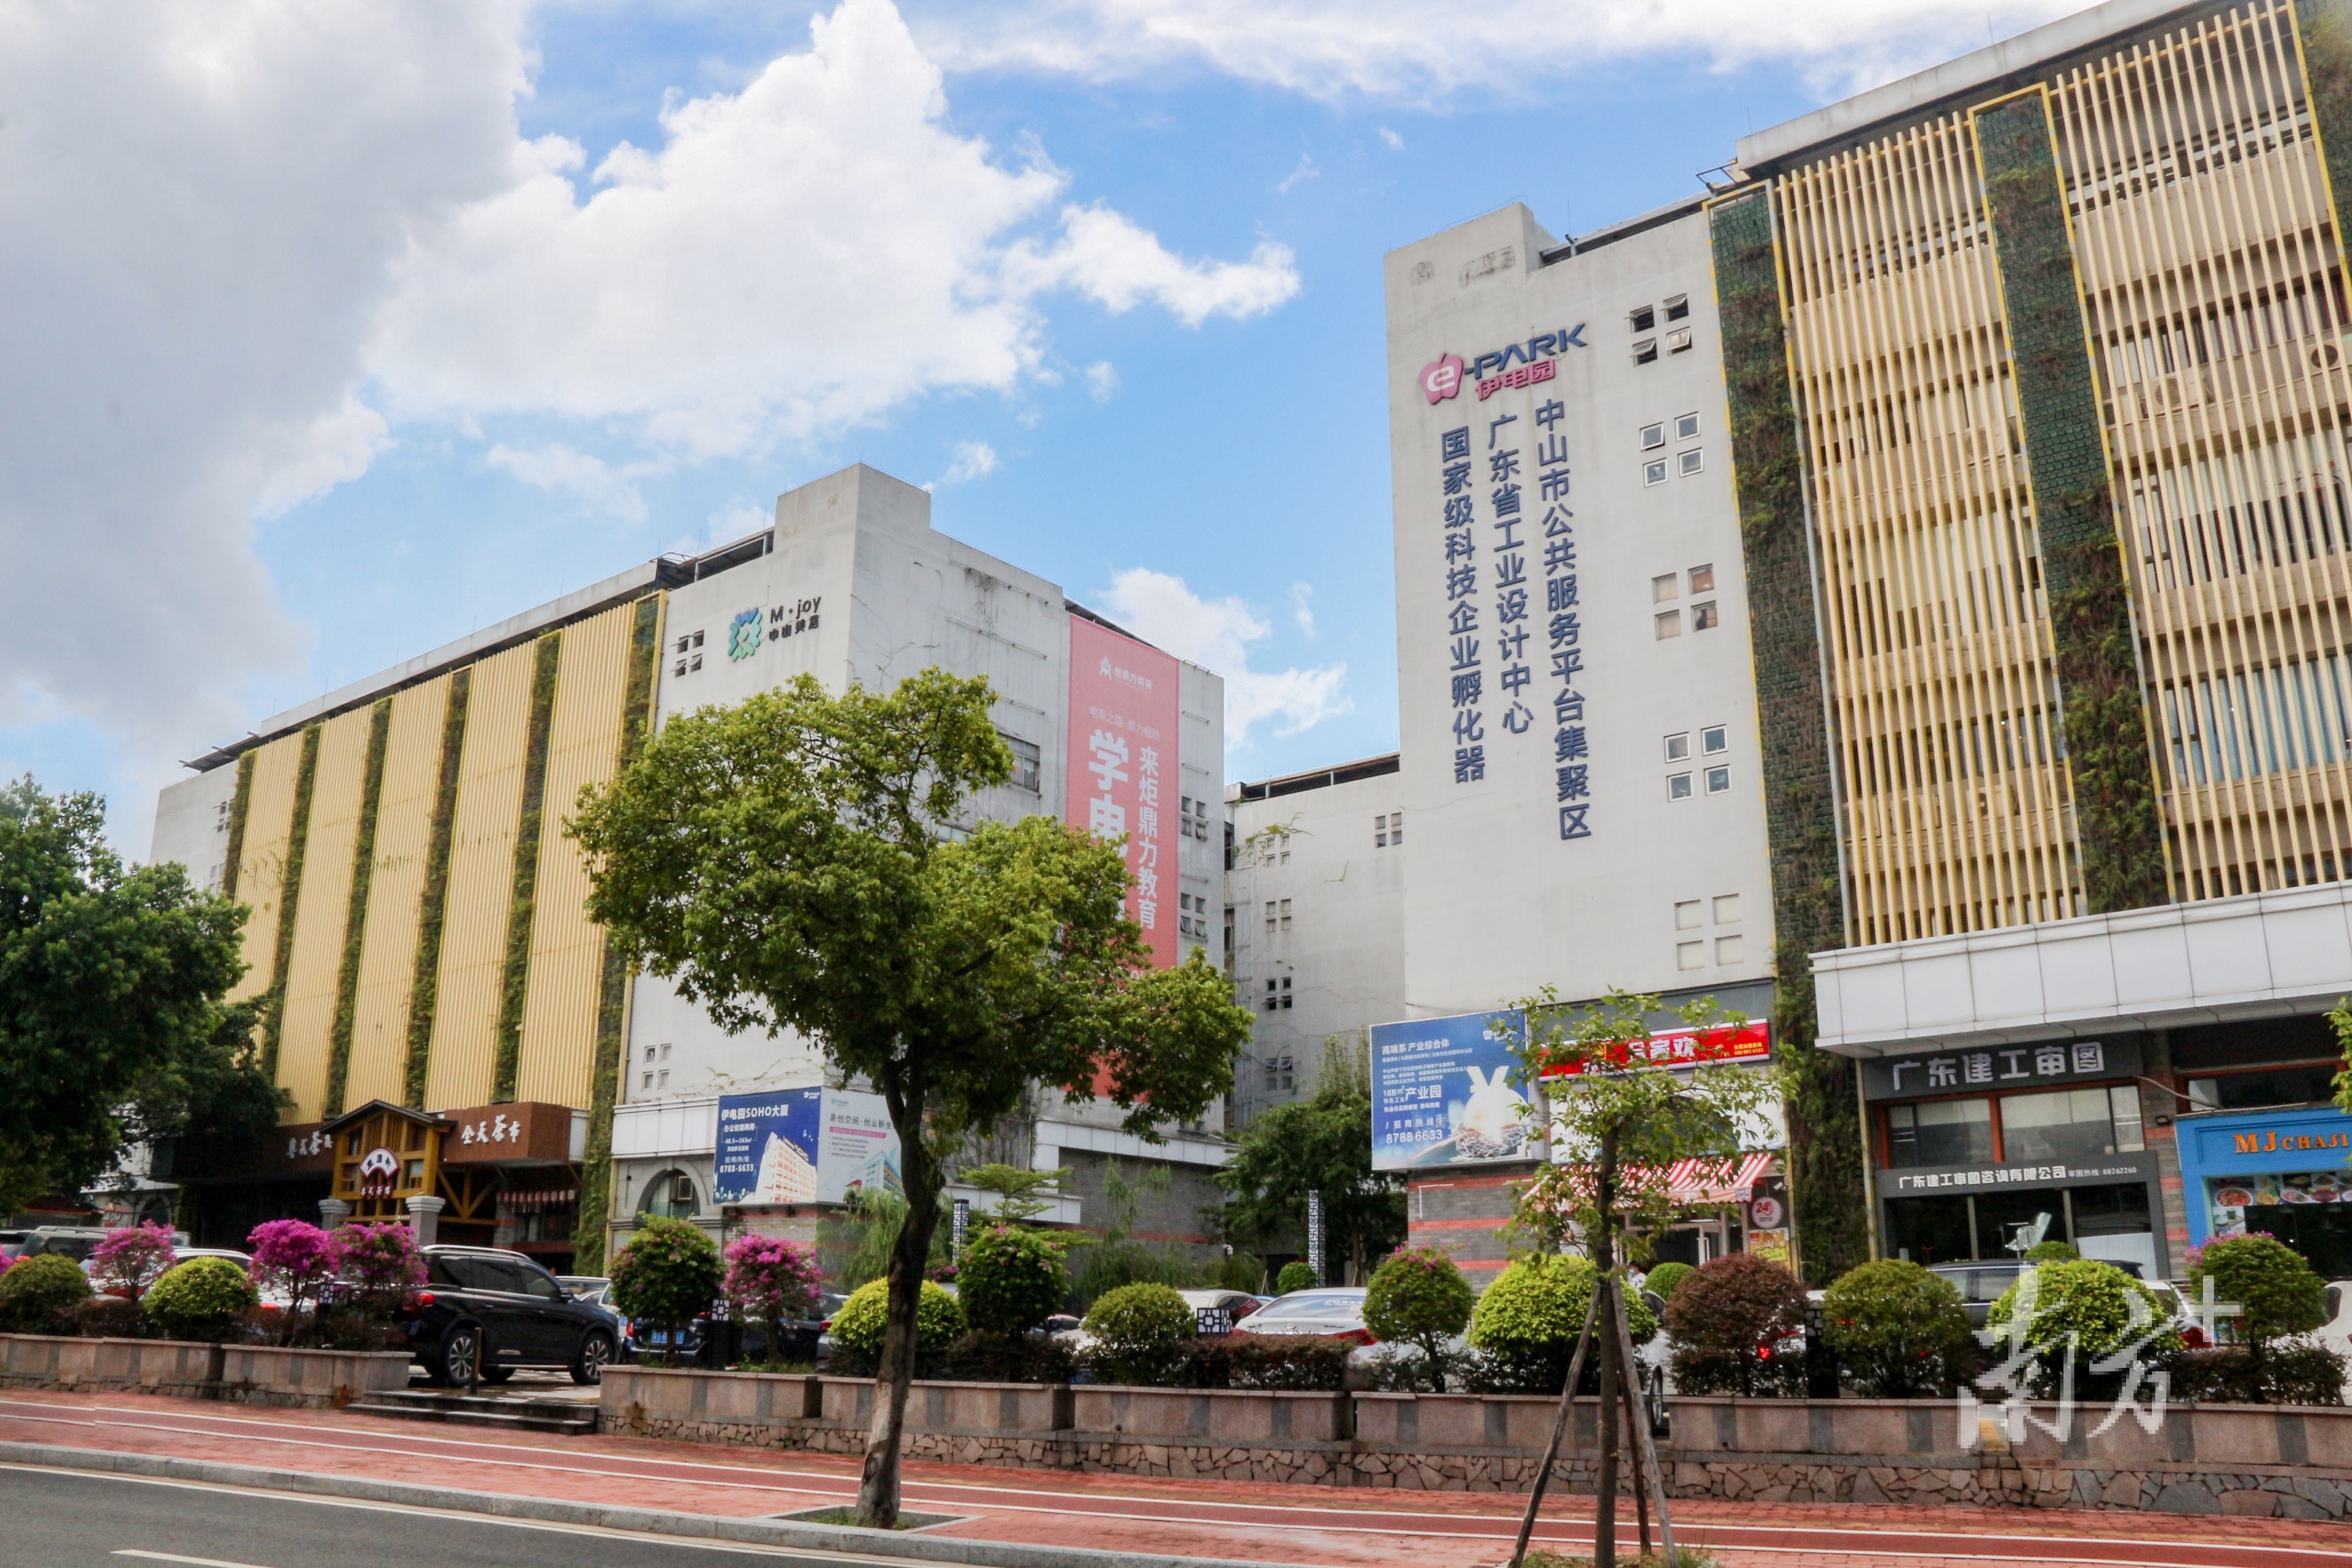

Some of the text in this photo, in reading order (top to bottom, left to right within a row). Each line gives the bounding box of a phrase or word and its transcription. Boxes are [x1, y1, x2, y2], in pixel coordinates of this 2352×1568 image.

[1475, 359, 1556, 402] 伊电园
[1488, 414, 1534, 734] 广东省工业设计中心
[1441, 425, 1485, 784] 国家级科技企业孵化器
[1535, 398, 1591, 840] 中山市公共服务平台集聚区
[1137, 746, 1158, 930] 来炬鼎力教育
[1893, 1041, 2105, 1091] 广东建工审图
[721, 1105, 789, 1121] 伊电园SOHO大厦
[1405, 1084, 1441, 1101] 产业园
[1386, 1129, 1443, 1143] 8788 6633
[719, 1164, 754, 1173] 8788-6633
[1899, 1165, 2066, 1190] 广东建工审图咨询有限公司
[2102, 1166, 2137, 1176] 88262260
